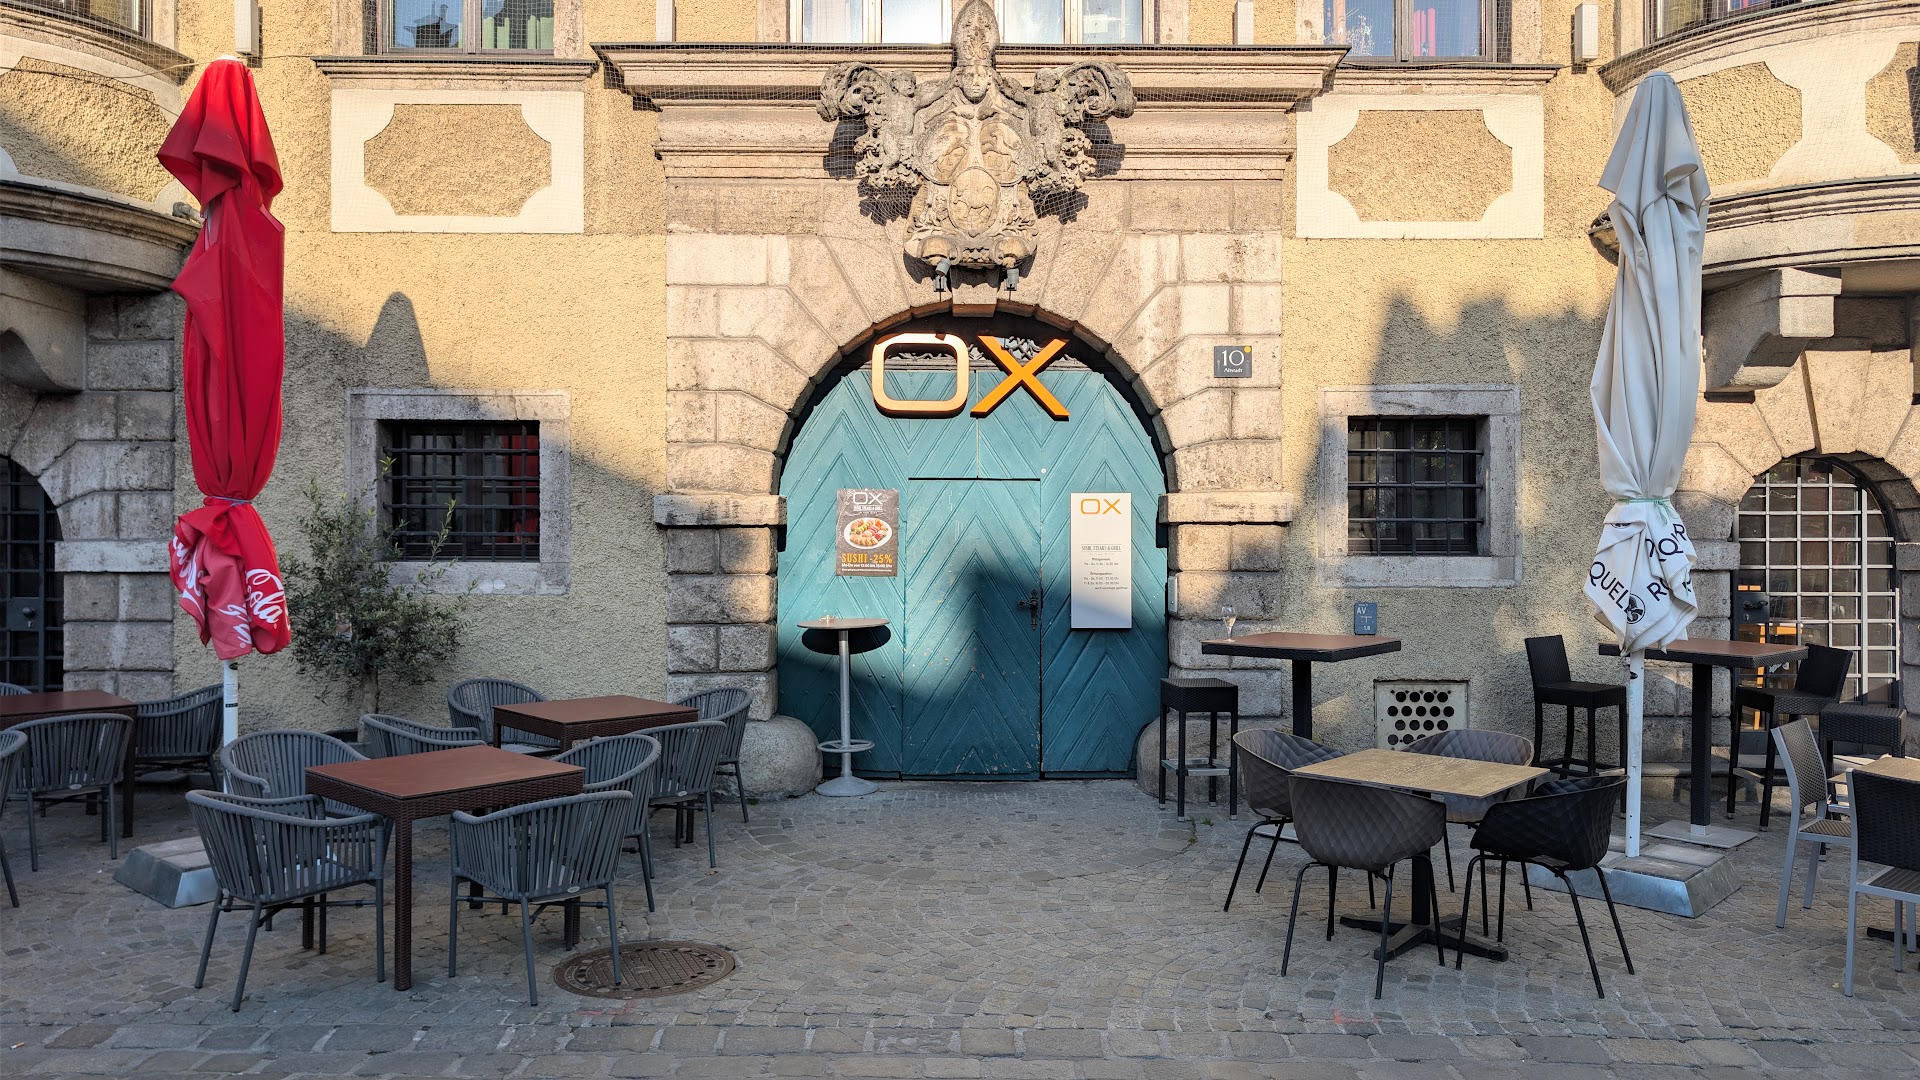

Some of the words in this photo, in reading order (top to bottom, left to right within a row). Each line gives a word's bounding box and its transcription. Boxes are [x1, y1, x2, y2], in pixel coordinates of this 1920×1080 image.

[1221, 350, 1245, 366] 10
[871, 332, 1071, 421] OX
[853, 492, 883, 505] OX
[1080, 498, 1121, 515] OX
[841, 553, 868, 563] SUSHI
[869, 554, 893, 564] -25%
[1356, 607, 1367, 615] AV
